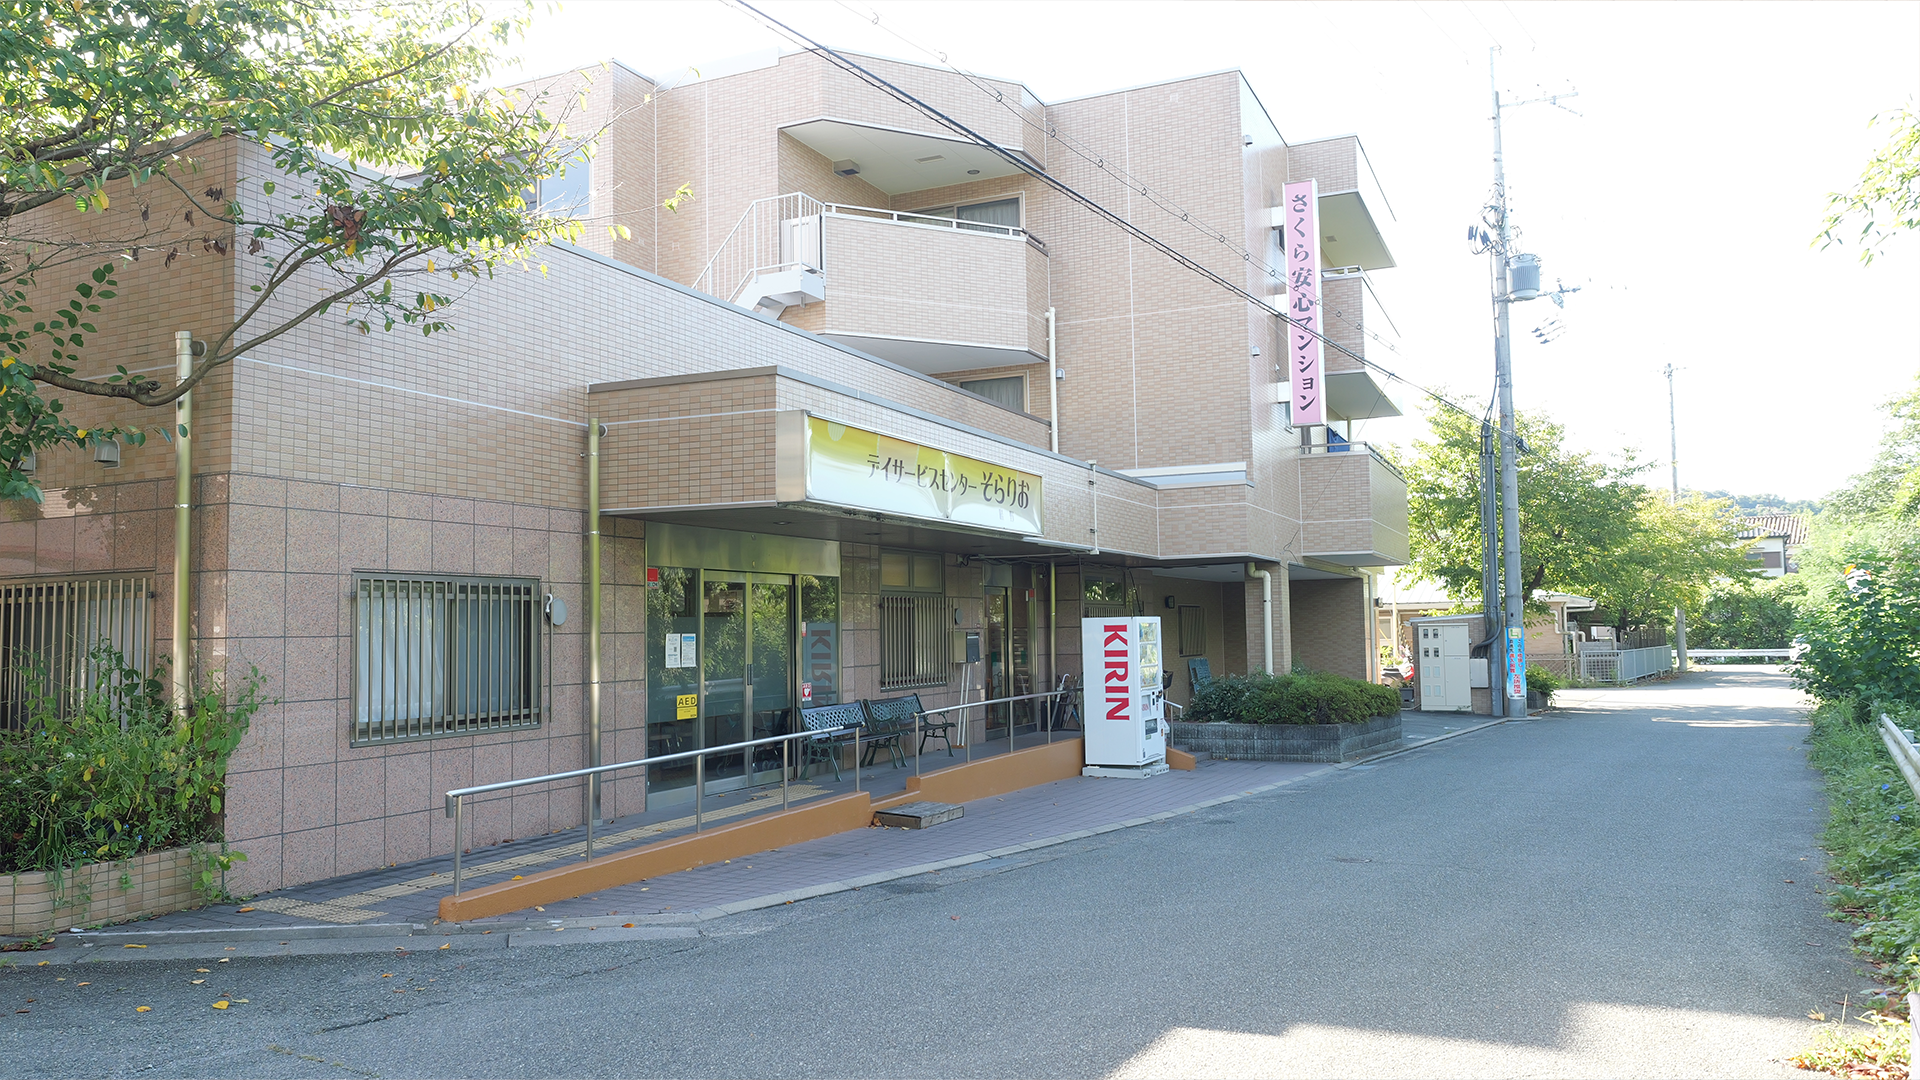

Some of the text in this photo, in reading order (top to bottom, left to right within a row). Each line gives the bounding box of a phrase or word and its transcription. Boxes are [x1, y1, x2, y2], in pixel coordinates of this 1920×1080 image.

[1291, 194, 1316, 411] さくら安心マンション
[867, 453, 1029, 509] デイサービスセンター そらりお
[678, 696, 696, 706] AED
[1104, 624, 1130, 721] KIRIN
